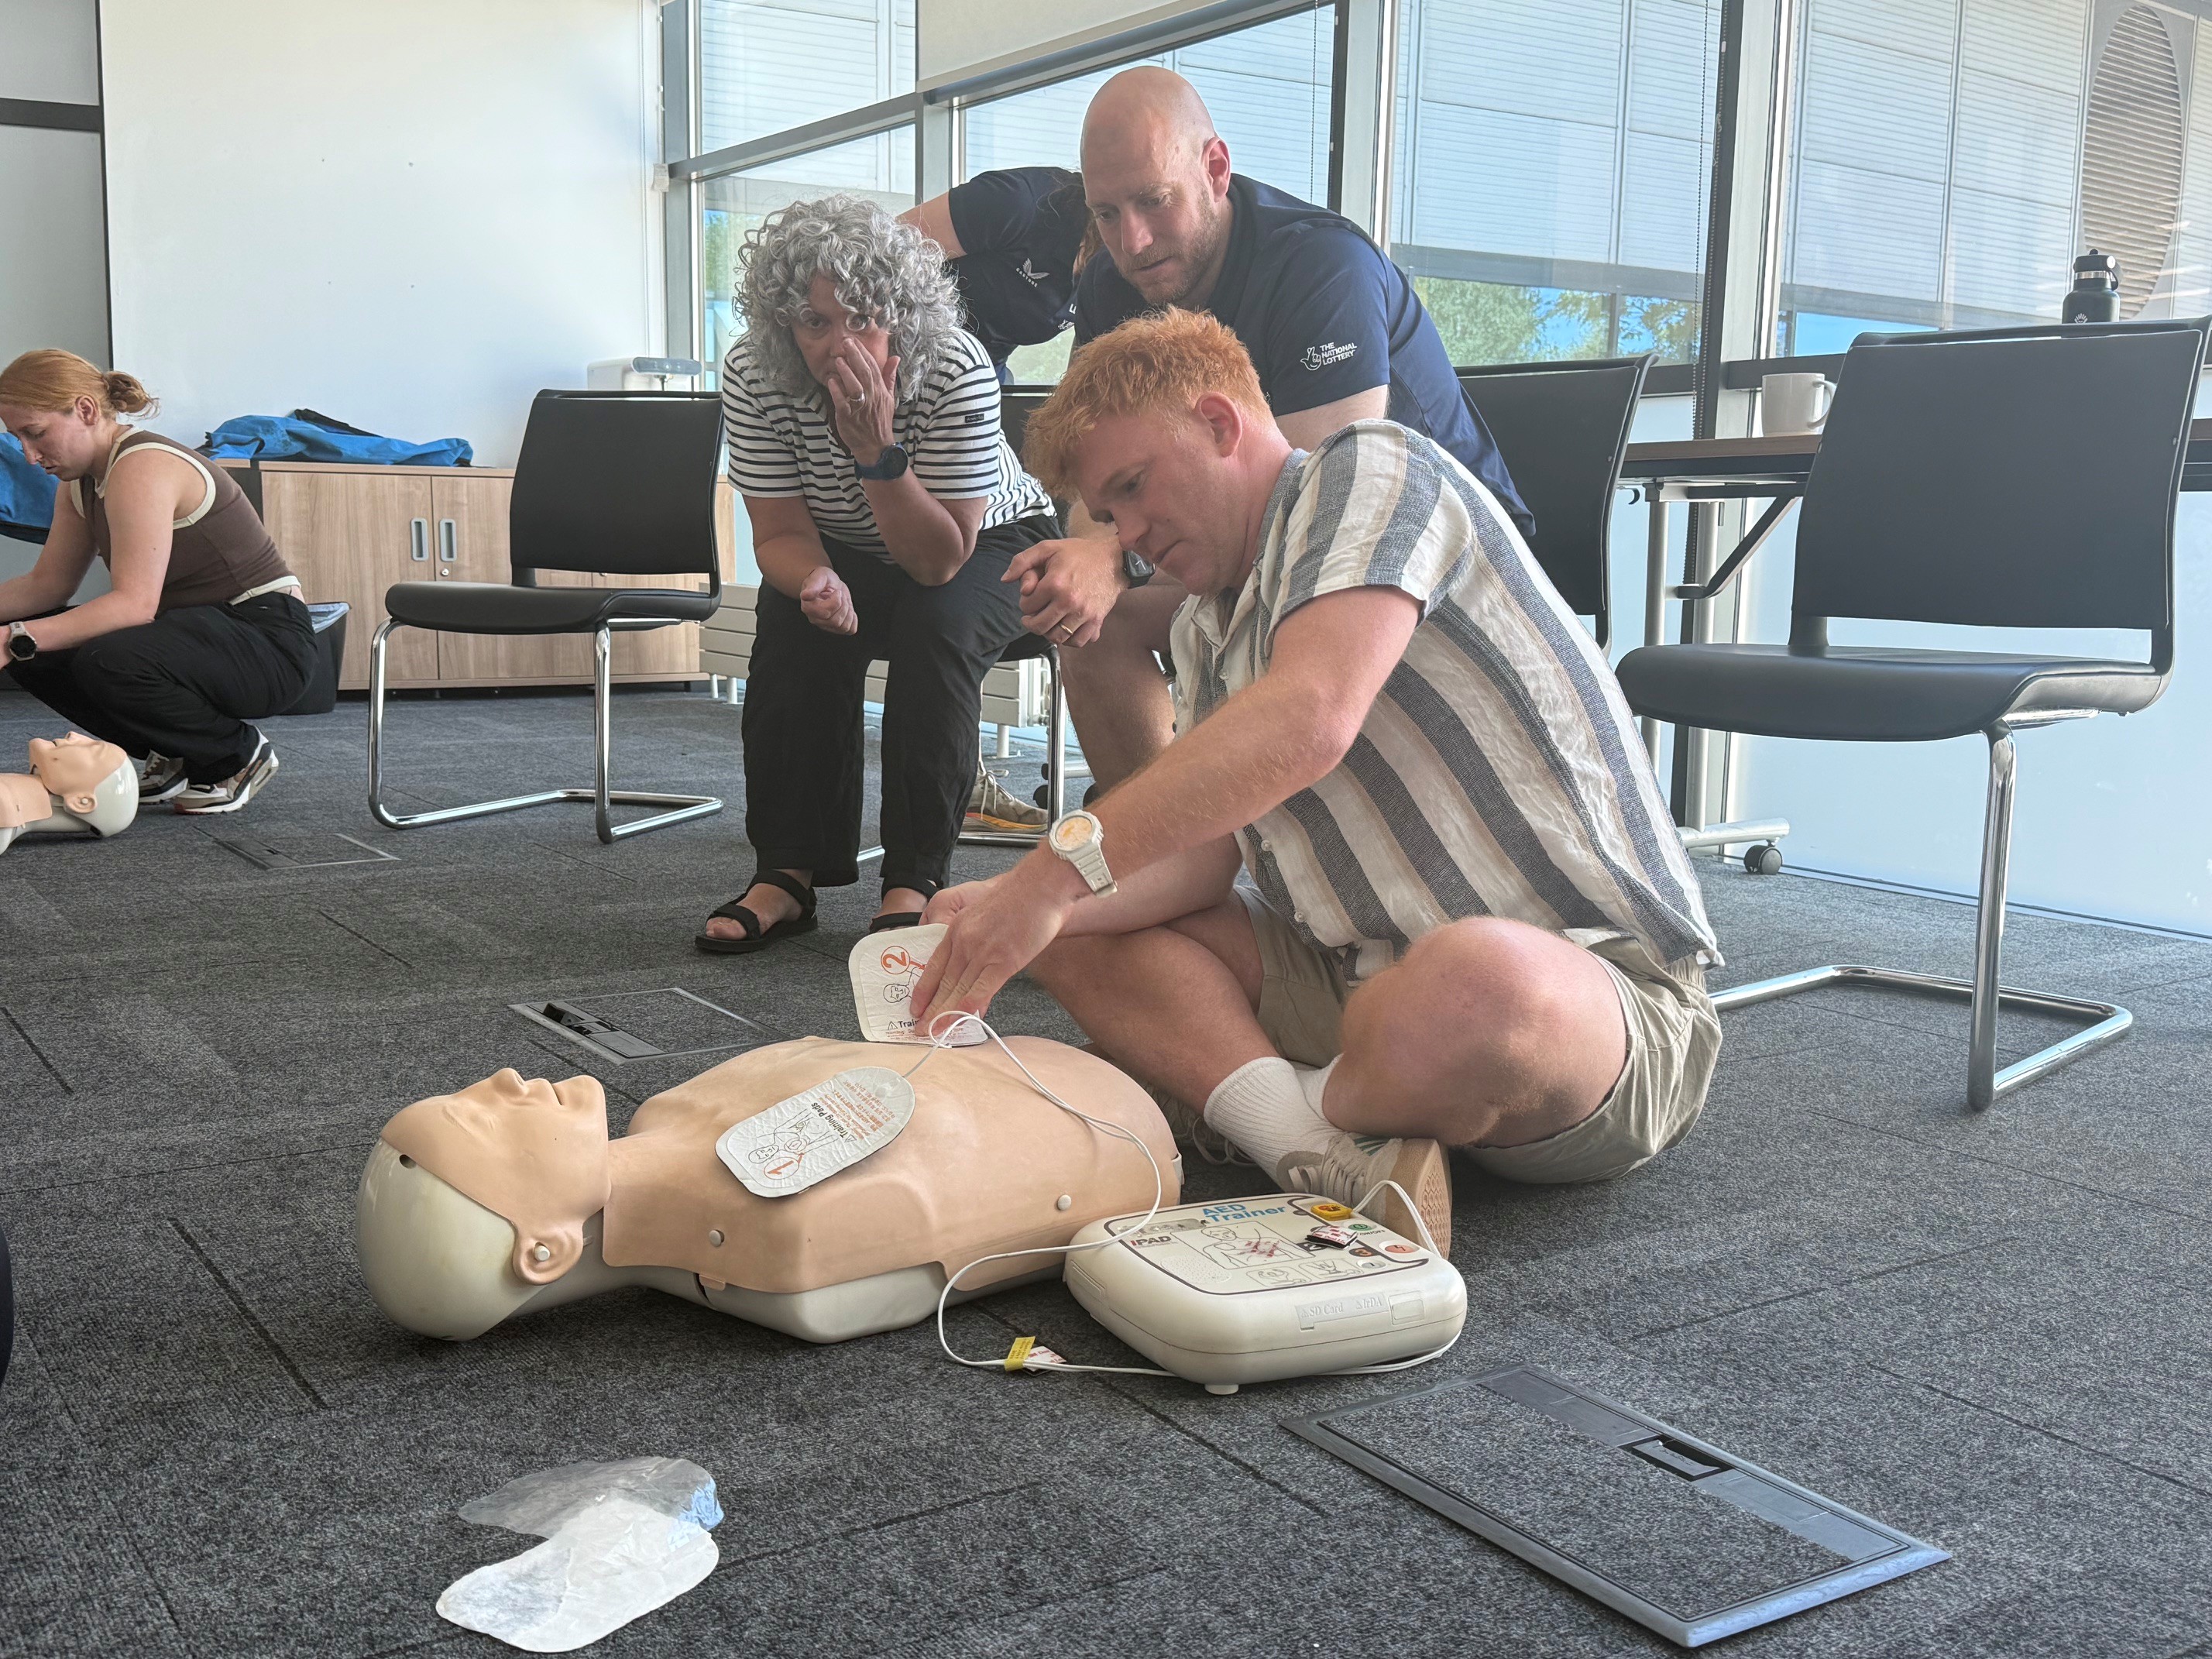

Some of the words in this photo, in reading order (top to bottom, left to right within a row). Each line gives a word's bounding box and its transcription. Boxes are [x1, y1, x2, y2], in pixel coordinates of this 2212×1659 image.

[1320, 342, 1335, 352] THE
[1321, 342, 1358, 358] NATIONAL
[1323, 349, 1355, 366] LOTTERY
[882, 951, 907, 969] 2
[811, 1102, 827, 1118] Pads
[825, 1114, 848, 1139] Training
[767, 1159, 795, 1176] 1
[1201, 1204, 1247, 1217] AED
[1206, 1206, 1287, 1224] Trainer
[1309, 1305, 1321, 1317] SD
[1324, 1302, 1344, 1315] Card
